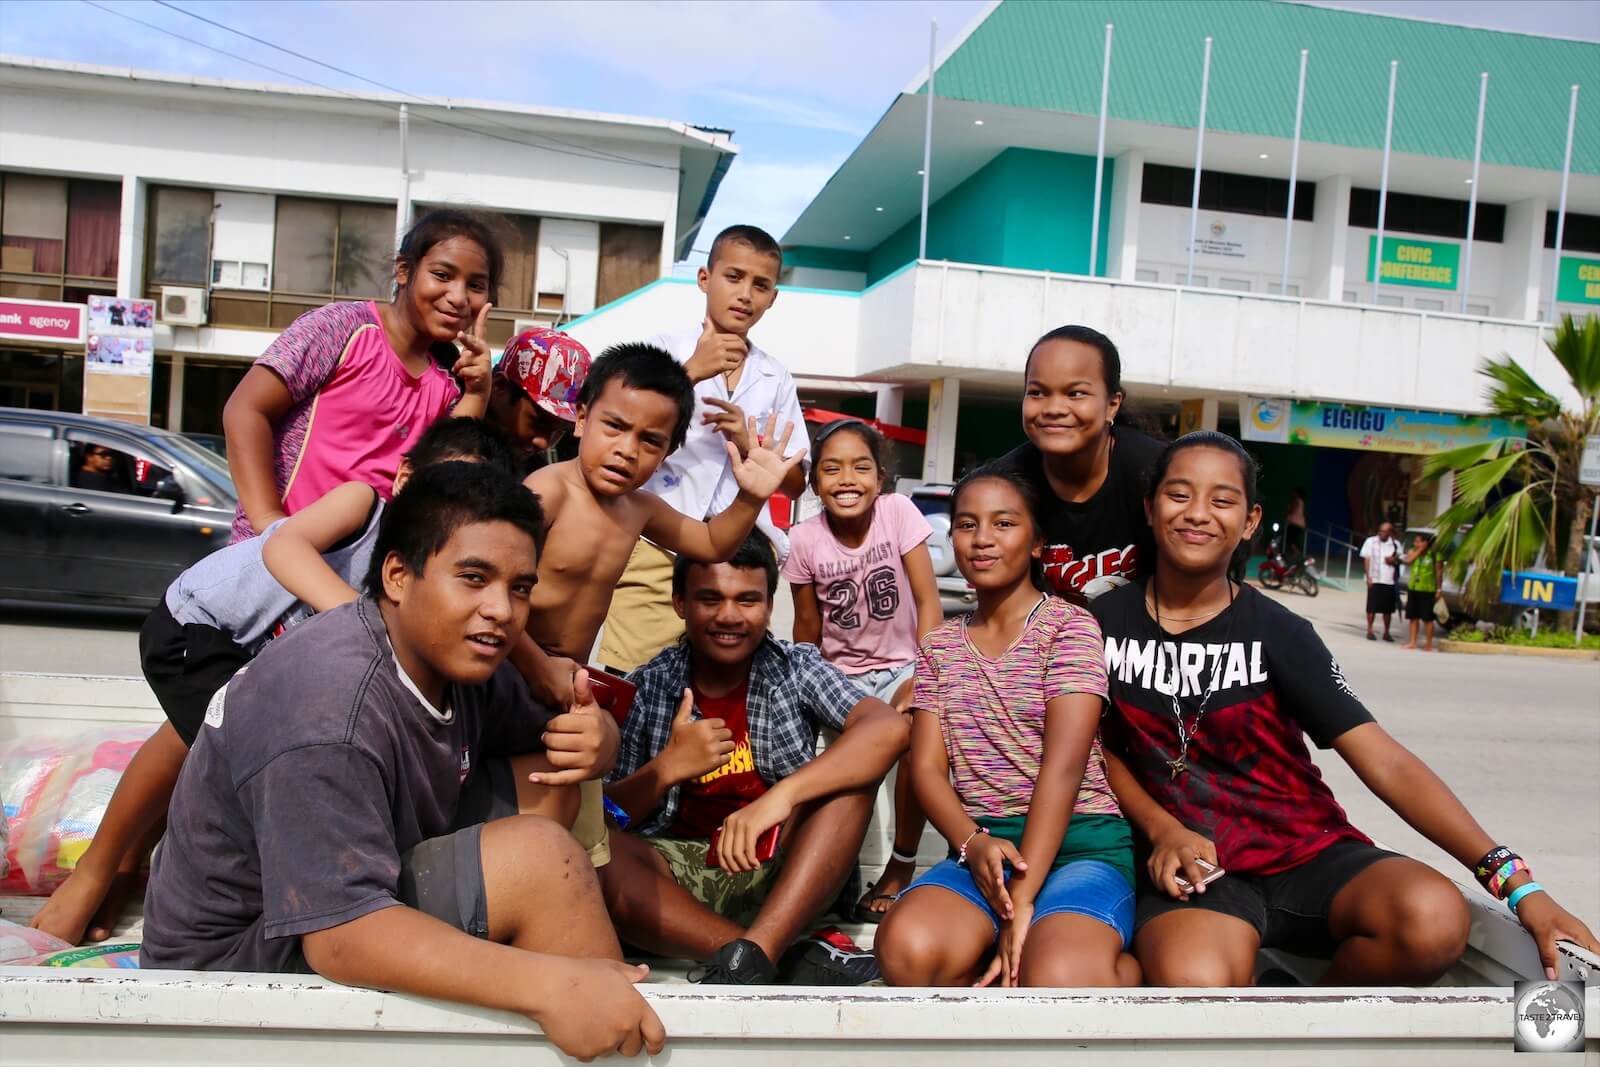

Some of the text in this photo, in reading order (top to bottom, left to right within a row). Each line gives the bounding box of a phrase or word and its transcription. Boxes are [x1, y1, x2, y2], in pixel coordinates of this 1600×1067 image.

[1397, 245, 1432, 264] CIVIC
[29, 316, 70, 330] agency
[1322, 407, 1385, 432] EIGIGU
[818, 559, 858, 578] SMALL
[827, 565, 899, 630] 26
[1522, 579, 1554, 603] IN
